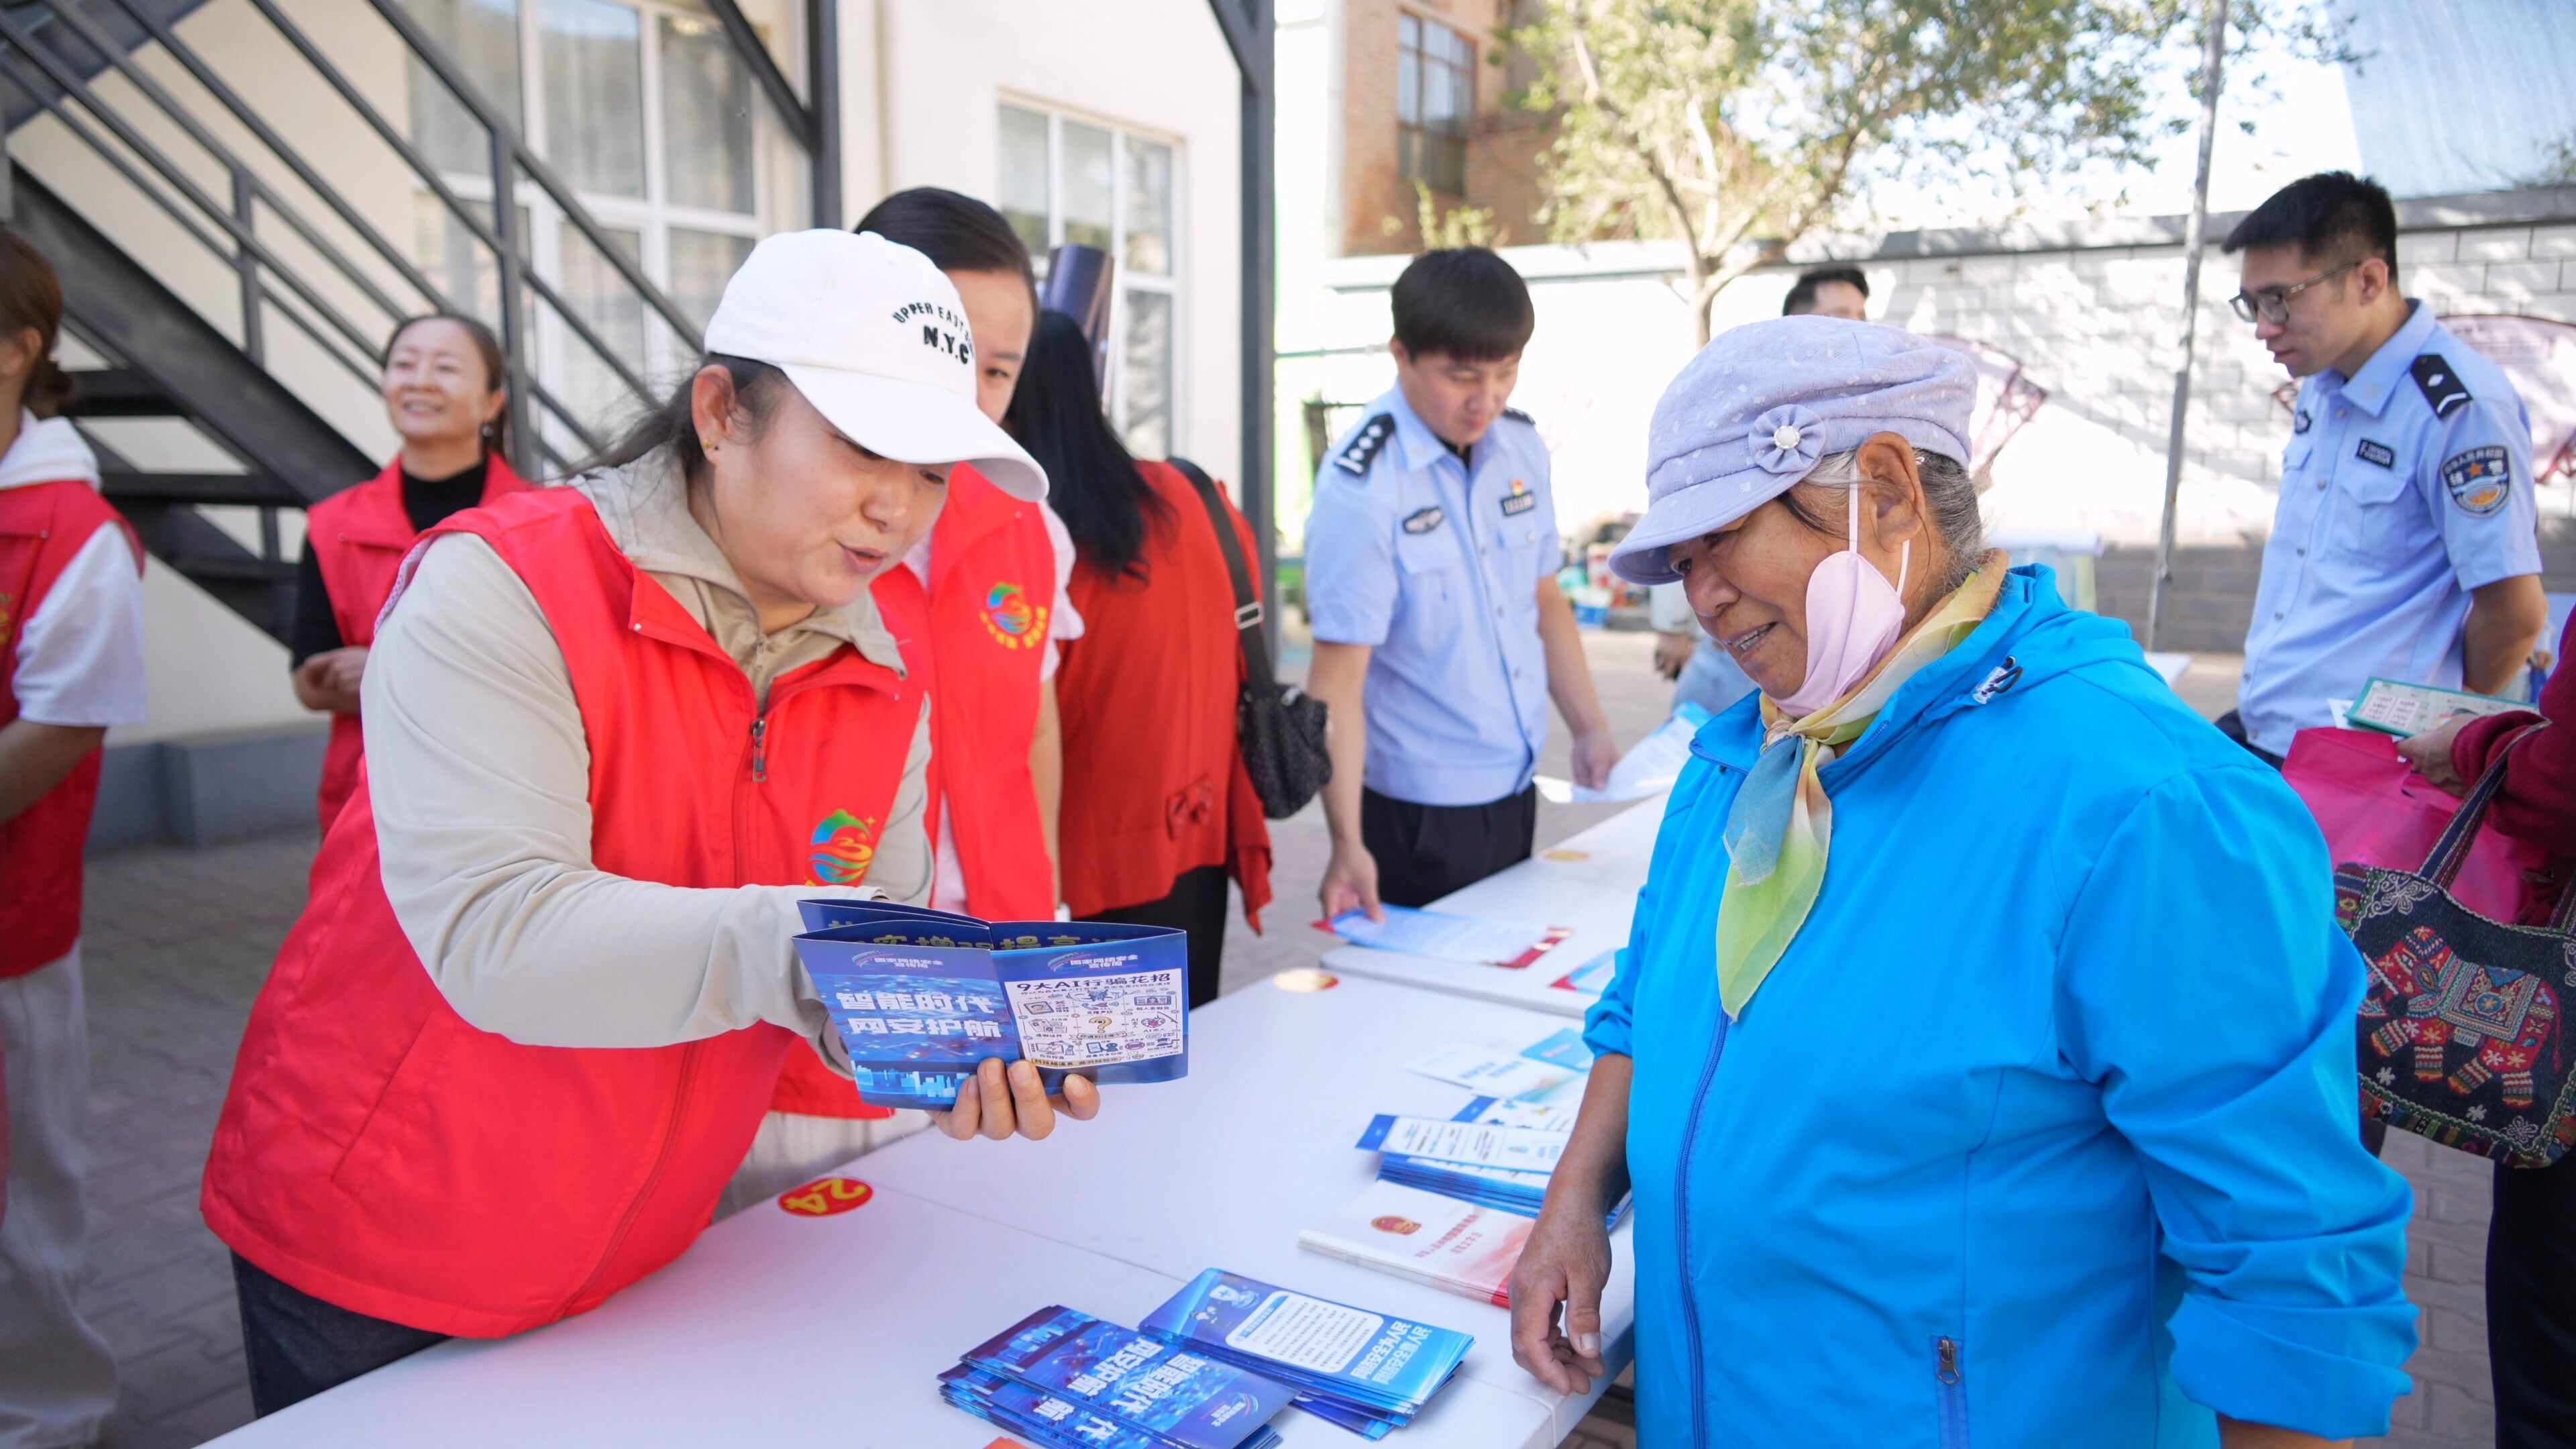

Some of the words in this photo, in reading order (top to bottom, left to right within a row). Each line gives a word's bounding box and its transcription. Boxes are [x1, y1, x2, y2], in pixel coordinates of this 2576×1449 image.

[892, 303, 933, 323] UPPER
[1016, 973, 1170, 991] 9大AI行骗花招
[836, 991, 995, 1014] 智能时代
[847, 1018, 1002, 1038] 网安护航
[1066, 1337, 1165, 1397] 网安护航
[1110, 1352, 1207, 1413] 智能时代
